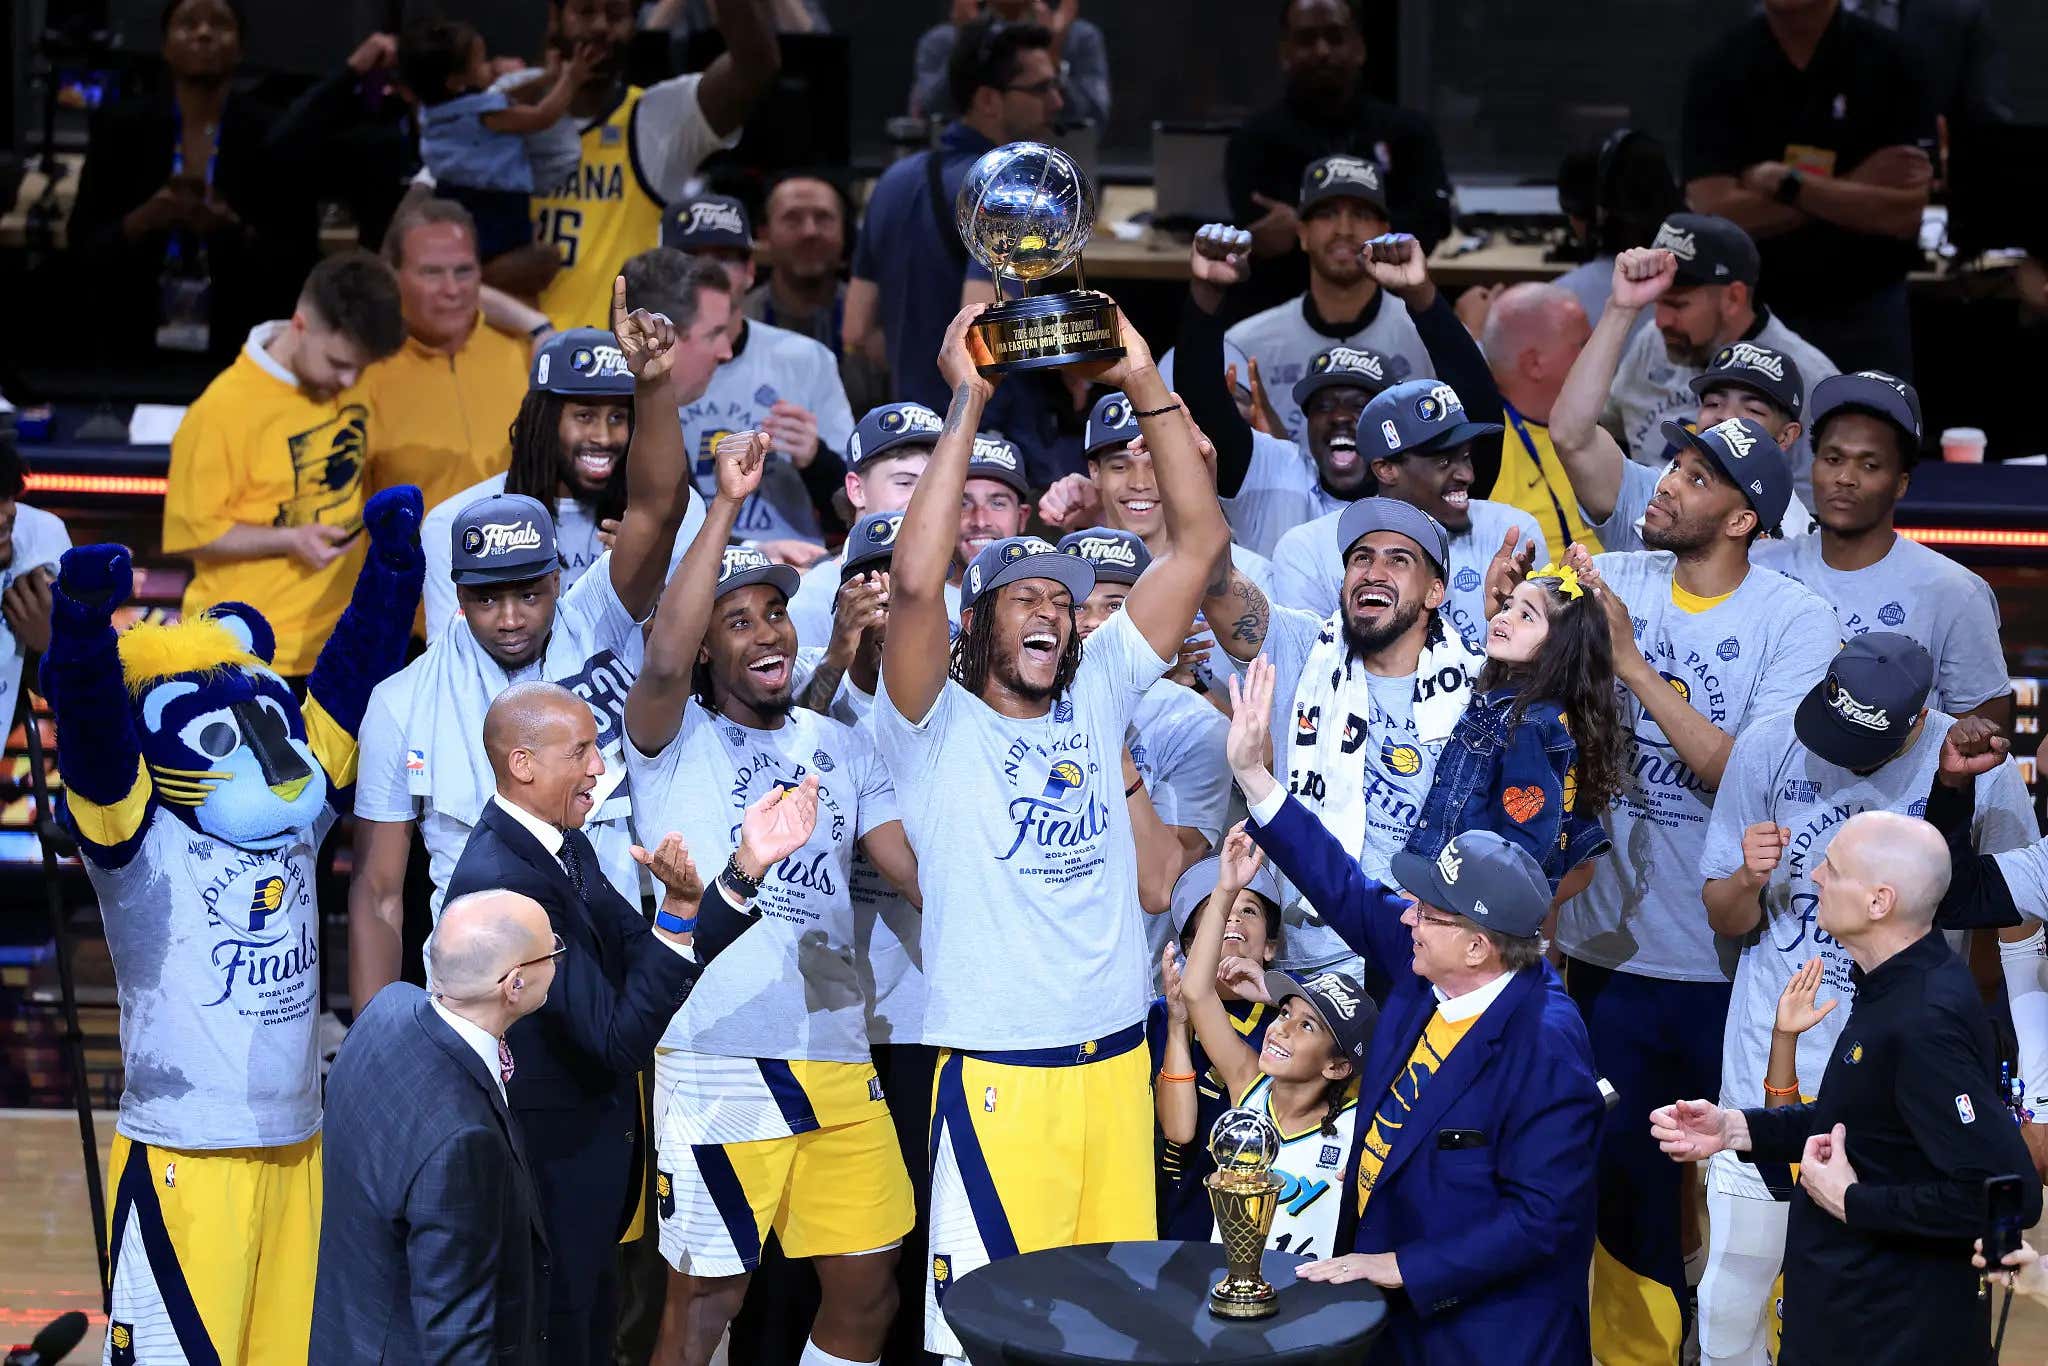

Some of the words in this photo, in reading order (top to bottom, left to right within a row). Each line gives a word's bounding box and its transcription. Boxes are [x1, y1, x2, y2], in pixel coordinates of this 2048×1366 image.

[684, 201, 743, 236] Finals
[1009, 338, 1038, 352] EASTERN
[1040, 332, 1081, 347] CONFERENCE
[1013, 328, 1027, 340] THE
[1325, 347, 1383, 381] Finals
[1720, 343, 1784, 381] Finals
[476, 521, 541, 558] Finals
[1079, 537, 1136, 567] Finals
[1684, 651, 1726, 724] PACER
[1829, 688, 1890, 731] Finals
[1657, 792, 1682, 801] 2025
[1798, 791, 1816, 803] ROOM
[1800, 780, 1822, 793] LOCKER
[792, 764, 845, 842] PCERS
[1064, 857, 1082, 865] NBA
[1074, 844, 1096, 855] 2025
[1045, 869, 1093, 884] CHAMPIONS
[1065, 858, 1105, 875] CONFEREN
[760, 882, 779, 893] 224
[787, 889, 806, 899] 2025
[201, 922, 316, 1007] Finals
[280, 996, 294, 1005] NBA
[1302, 973, 1360, 1020] Finals
[1277, 1169, 1330, 1217] DY
